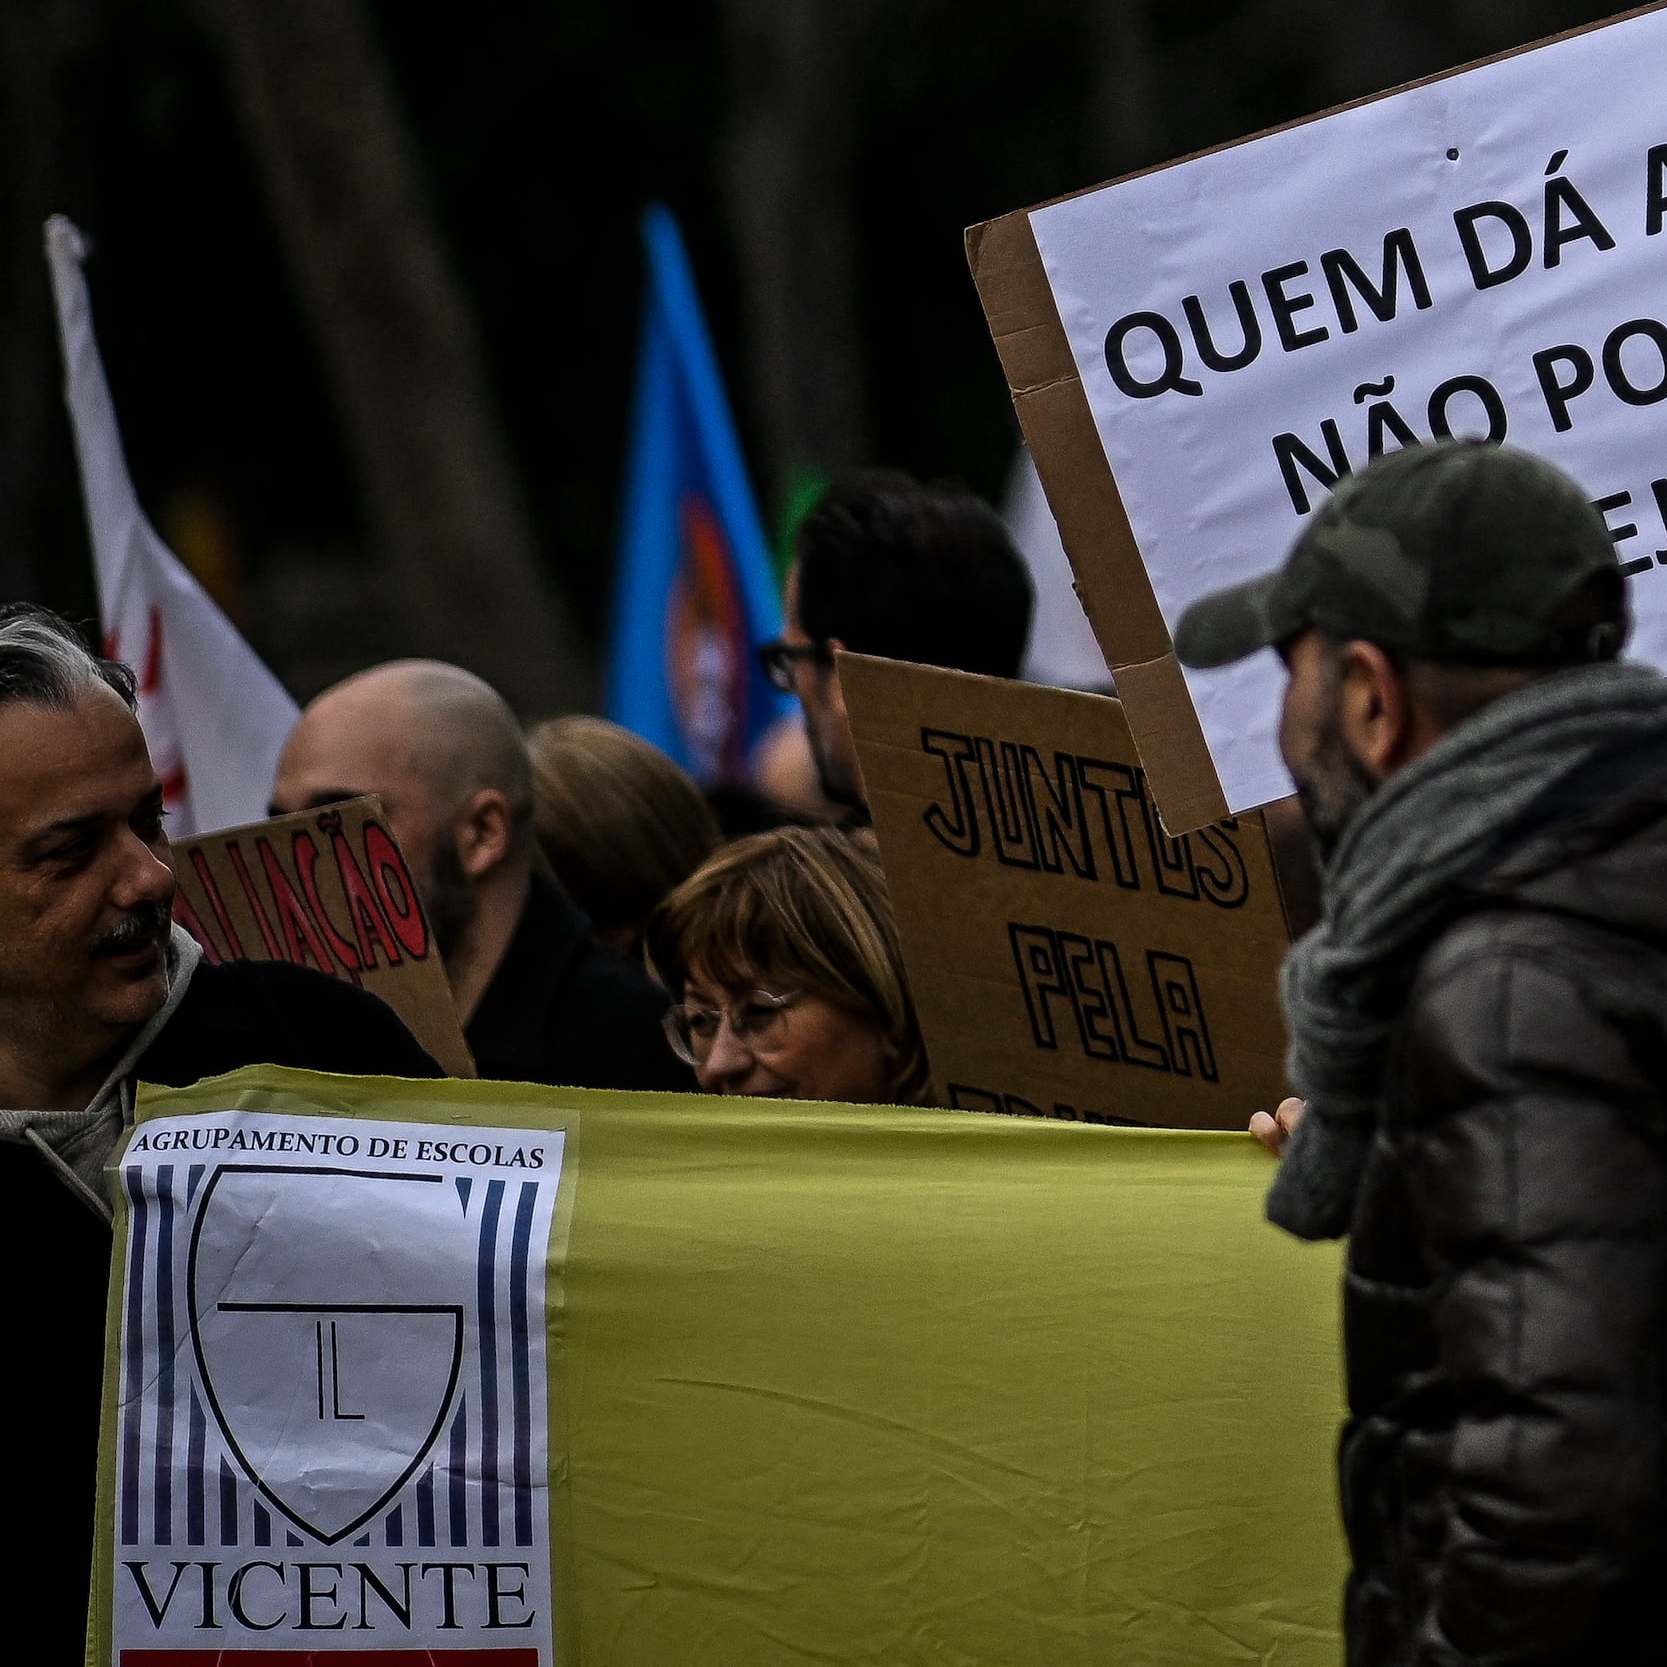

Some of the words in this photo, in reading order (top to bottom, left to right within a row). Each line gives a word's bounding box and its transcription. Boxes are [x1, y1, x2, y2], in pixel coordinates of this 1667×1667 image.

[1103, 226, 1433, 399] QUEM
[1453, 148, 1617, 291] DÁ
[1271, 375, 1509, 516] NÃO
[920, 727, 1250, 909] JUNTOS
[1008, 921, 1219, 1083] PELA
[131, 1127, 360, 1158] AGRUPAMENTO
[368, 1137, 408, 1160] DE
[415, 1140, 546, 1170] ESCOLAS
[120, 1560, 537, 1632] VICENTE
